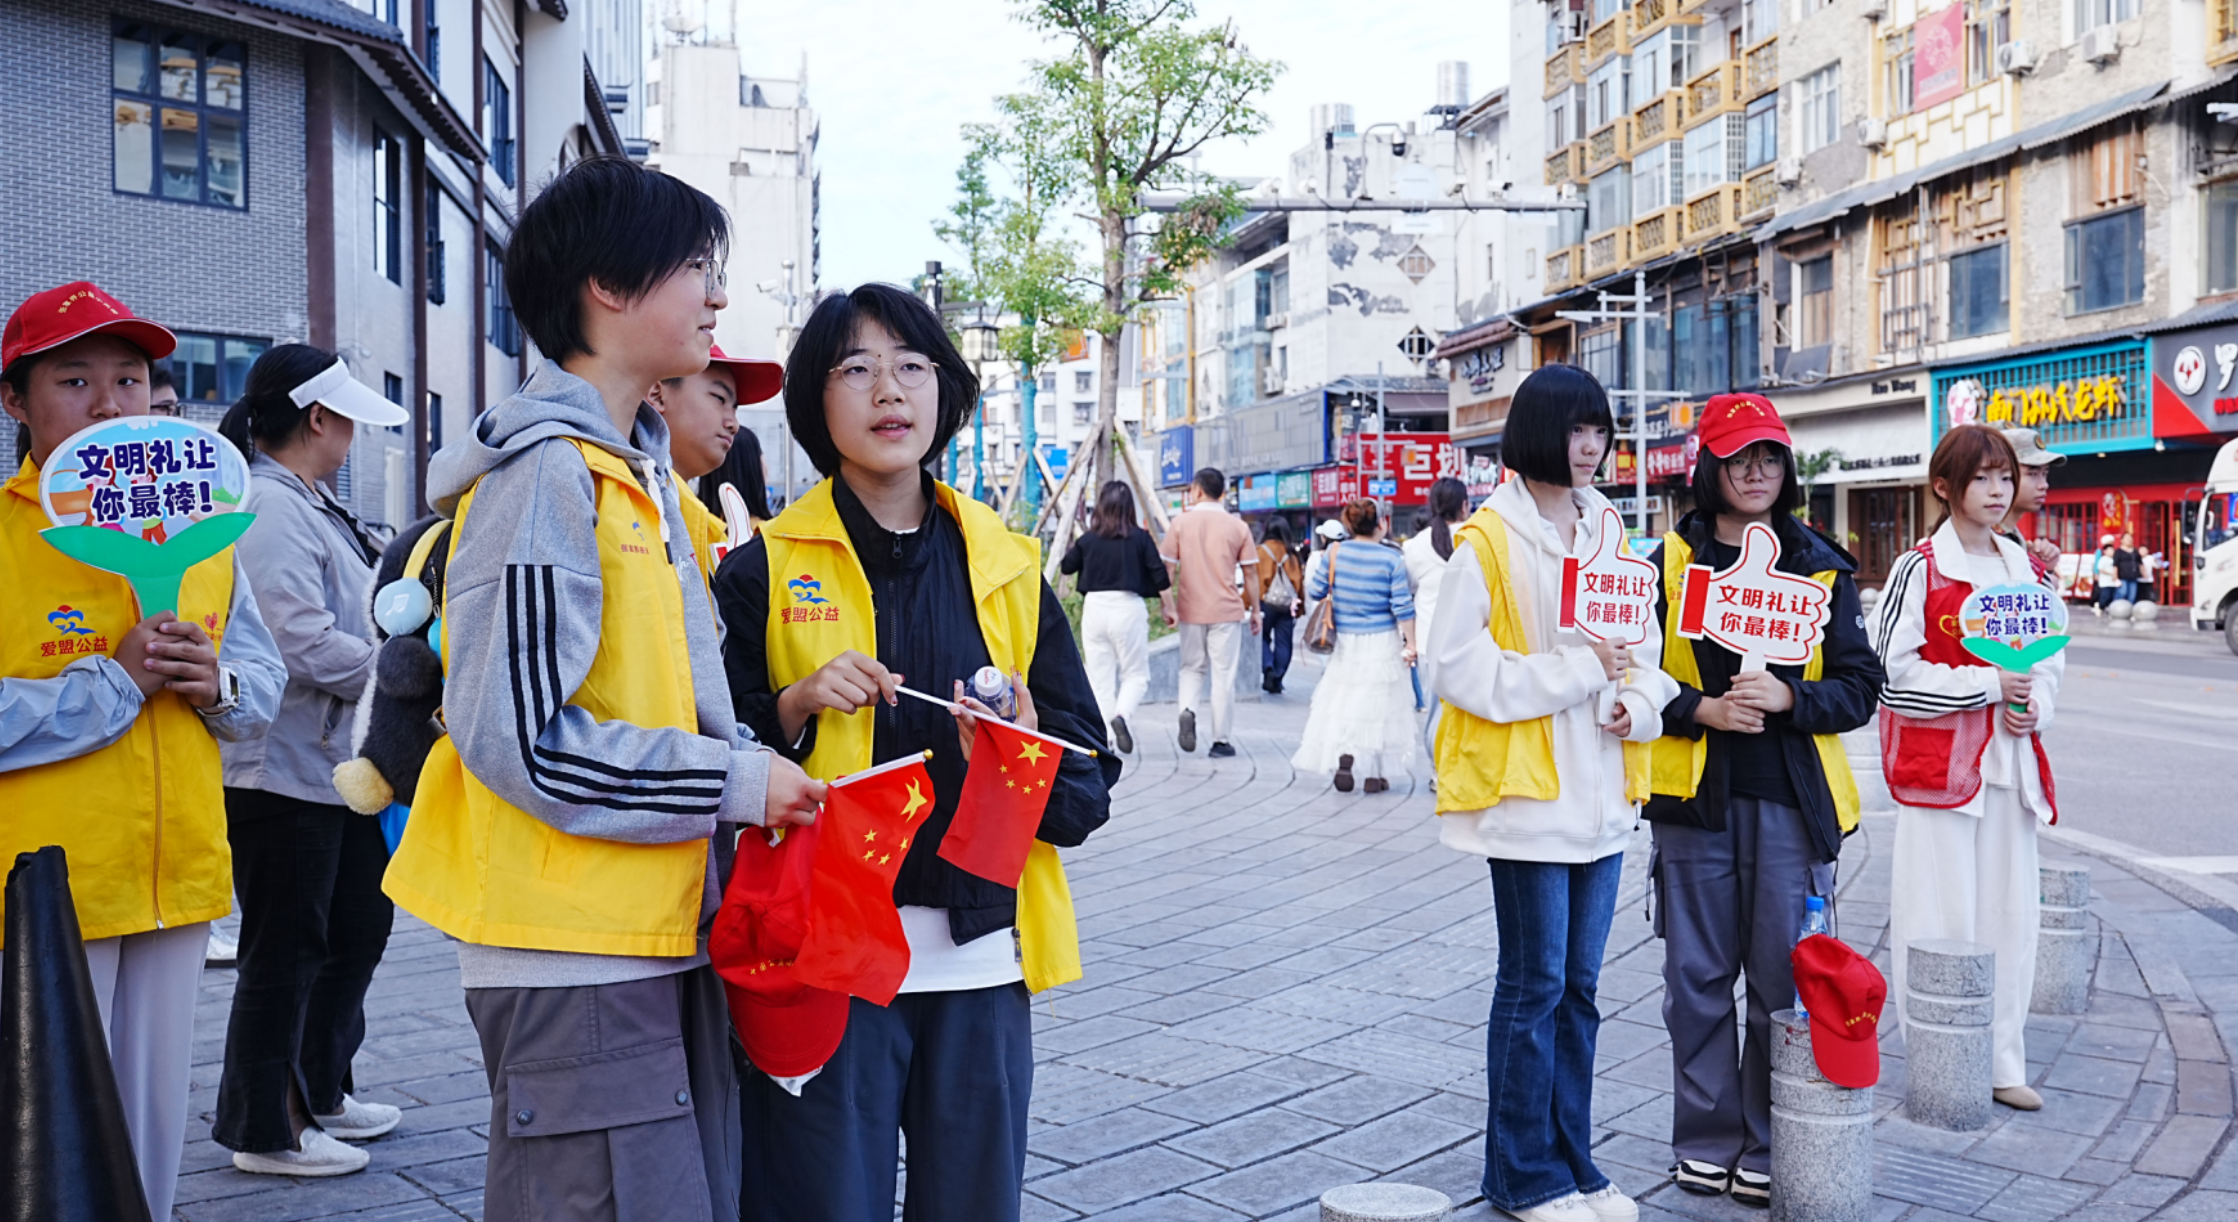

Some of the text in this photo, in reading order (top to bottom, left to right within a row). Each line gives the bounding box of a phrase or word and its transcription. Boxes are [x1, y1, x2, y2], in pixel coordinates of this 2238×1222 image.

[76, 439, 216, 479] 文明礼让
[1583, 572, 1646, 597] 文明礼让
[1717, 585, 1812, 616] 文明礼让
[1979, 594, 2050, 612] 文明礼让
[781, 606, 840, 624] 爱盟公益
[40, 636, 109, 657] 爱盟公益
